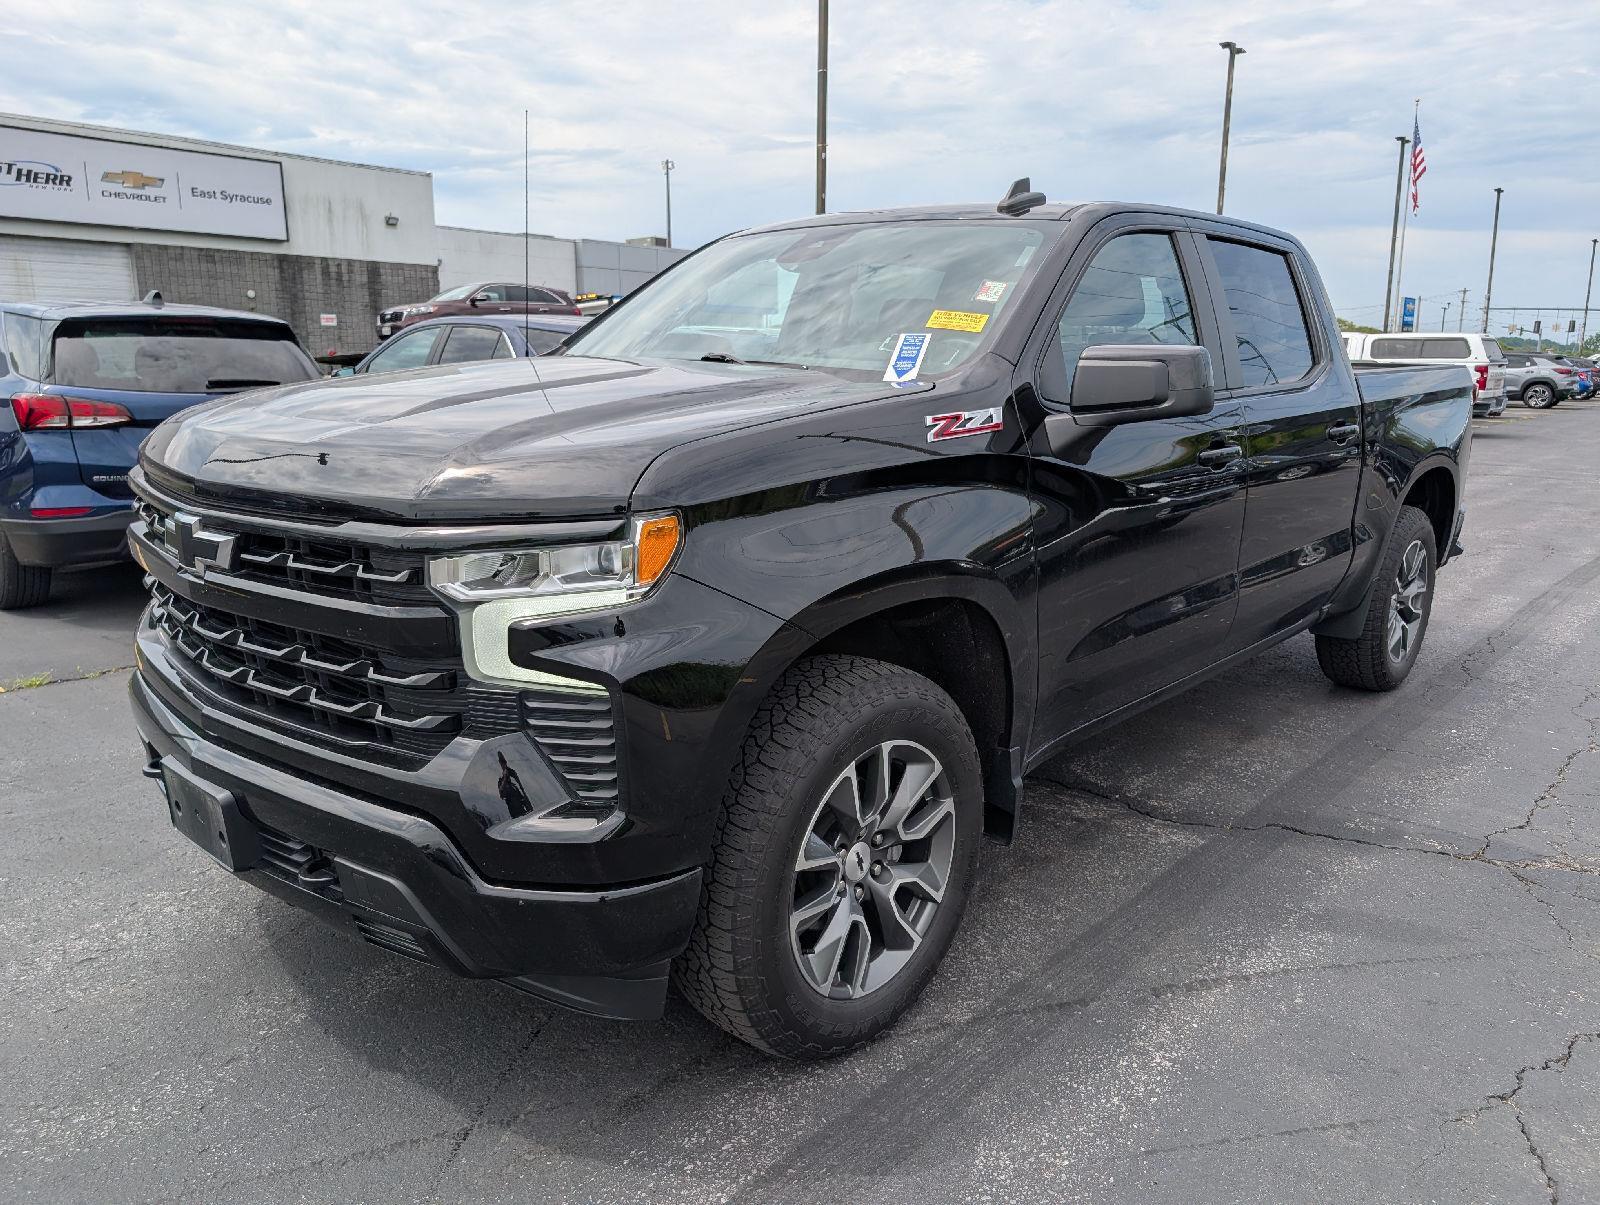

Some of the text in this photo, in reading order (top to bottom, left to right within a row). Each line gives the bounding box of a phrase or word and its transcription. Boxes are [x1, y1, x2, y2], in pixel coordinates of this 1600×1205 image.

[15, 168, 73, 187] HERR
[101, 189, 167, 203] CHEVROLET
[191, 187, 273, 206] East Syracuse
[925, 406, 1003, 443] Z71
